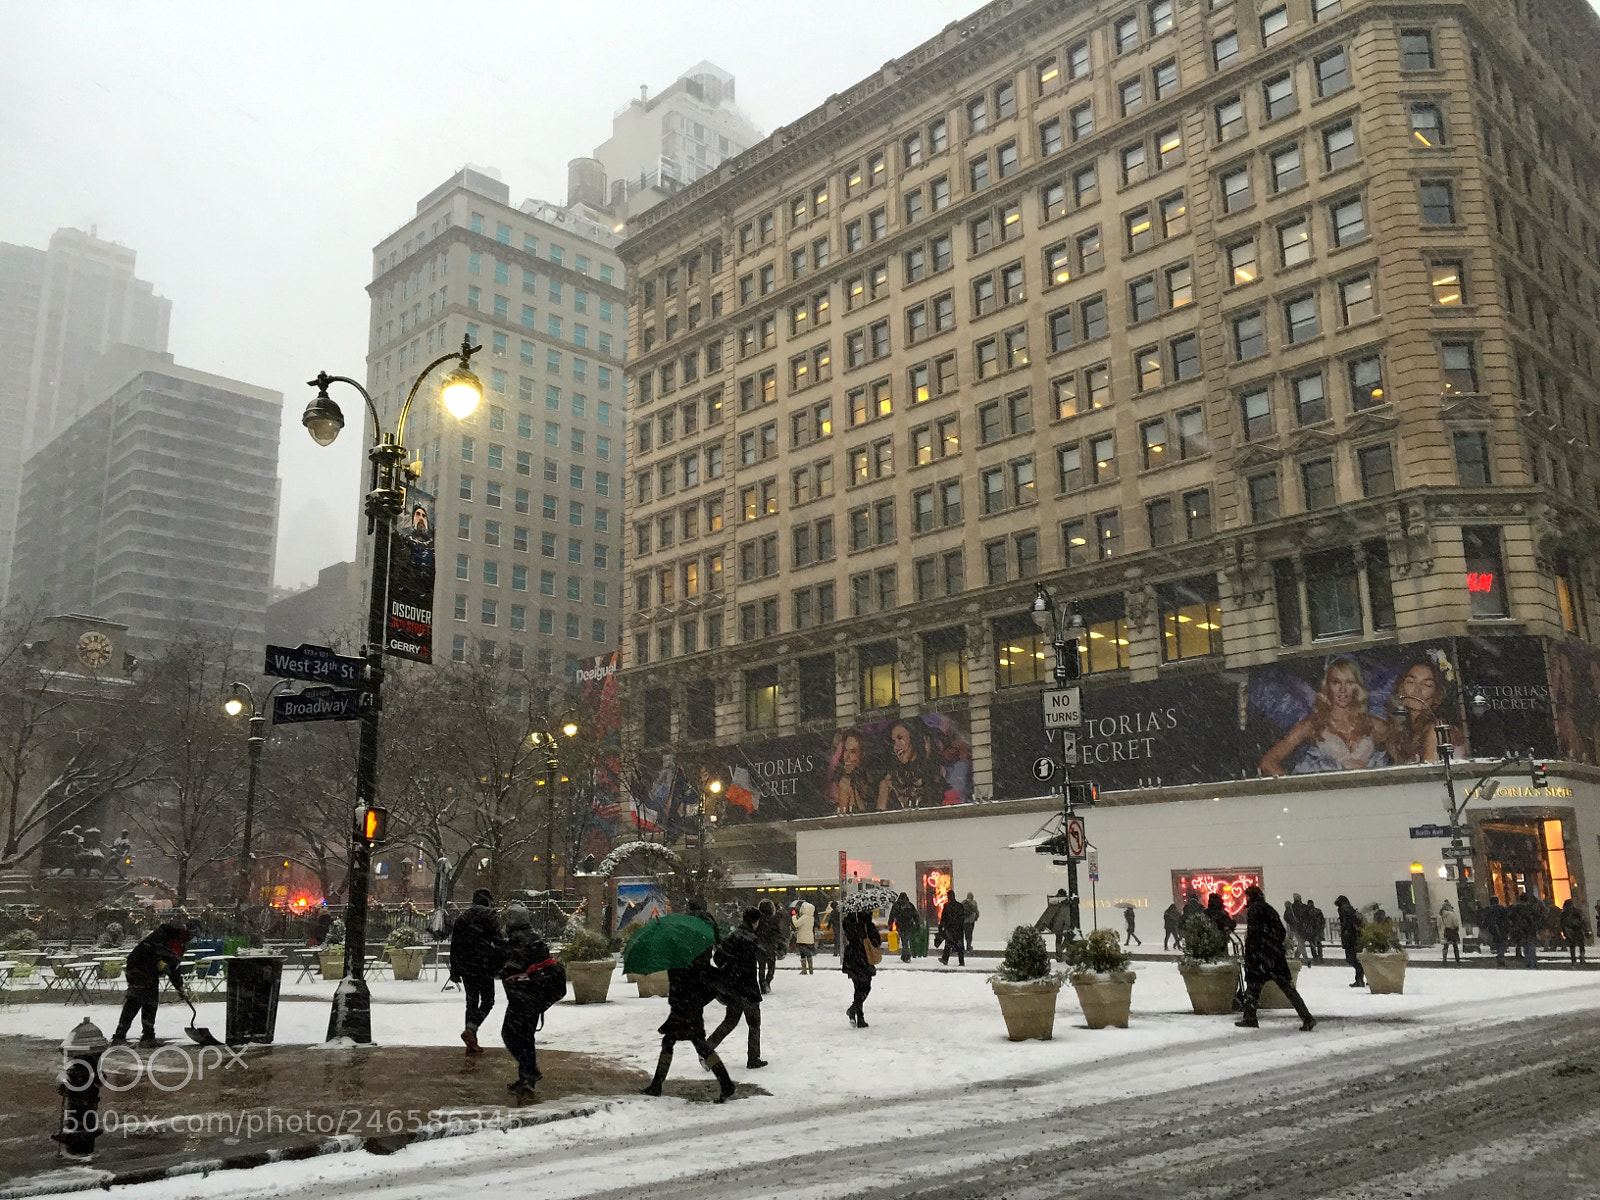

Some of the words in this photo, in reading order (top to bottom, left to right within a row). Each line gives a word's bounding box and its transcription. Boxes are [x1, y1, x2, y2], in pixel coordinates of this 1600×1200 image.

[392, 601, 431, 625] DISCOVER
[390, 638, 421, 654] GERRY
[274, 654, 310, 673] West
[312, 660, 338, 675] 34th
[341, 664, 355, 679] St
[1052, 695, 1070, 707] NO
[1465, 685, 1548, 697] VCTORIA'S
[285, 698, 349, 716] Broadway
[1046, 711, 1079, 723] TURNS
[1045, 708, 1177, 743] VTORIA'S
[1081, 737, 1155, 765] ECRET
[727, 754, 814, 781] VTORIA'S
[760, 777, 799, 798] CRET
